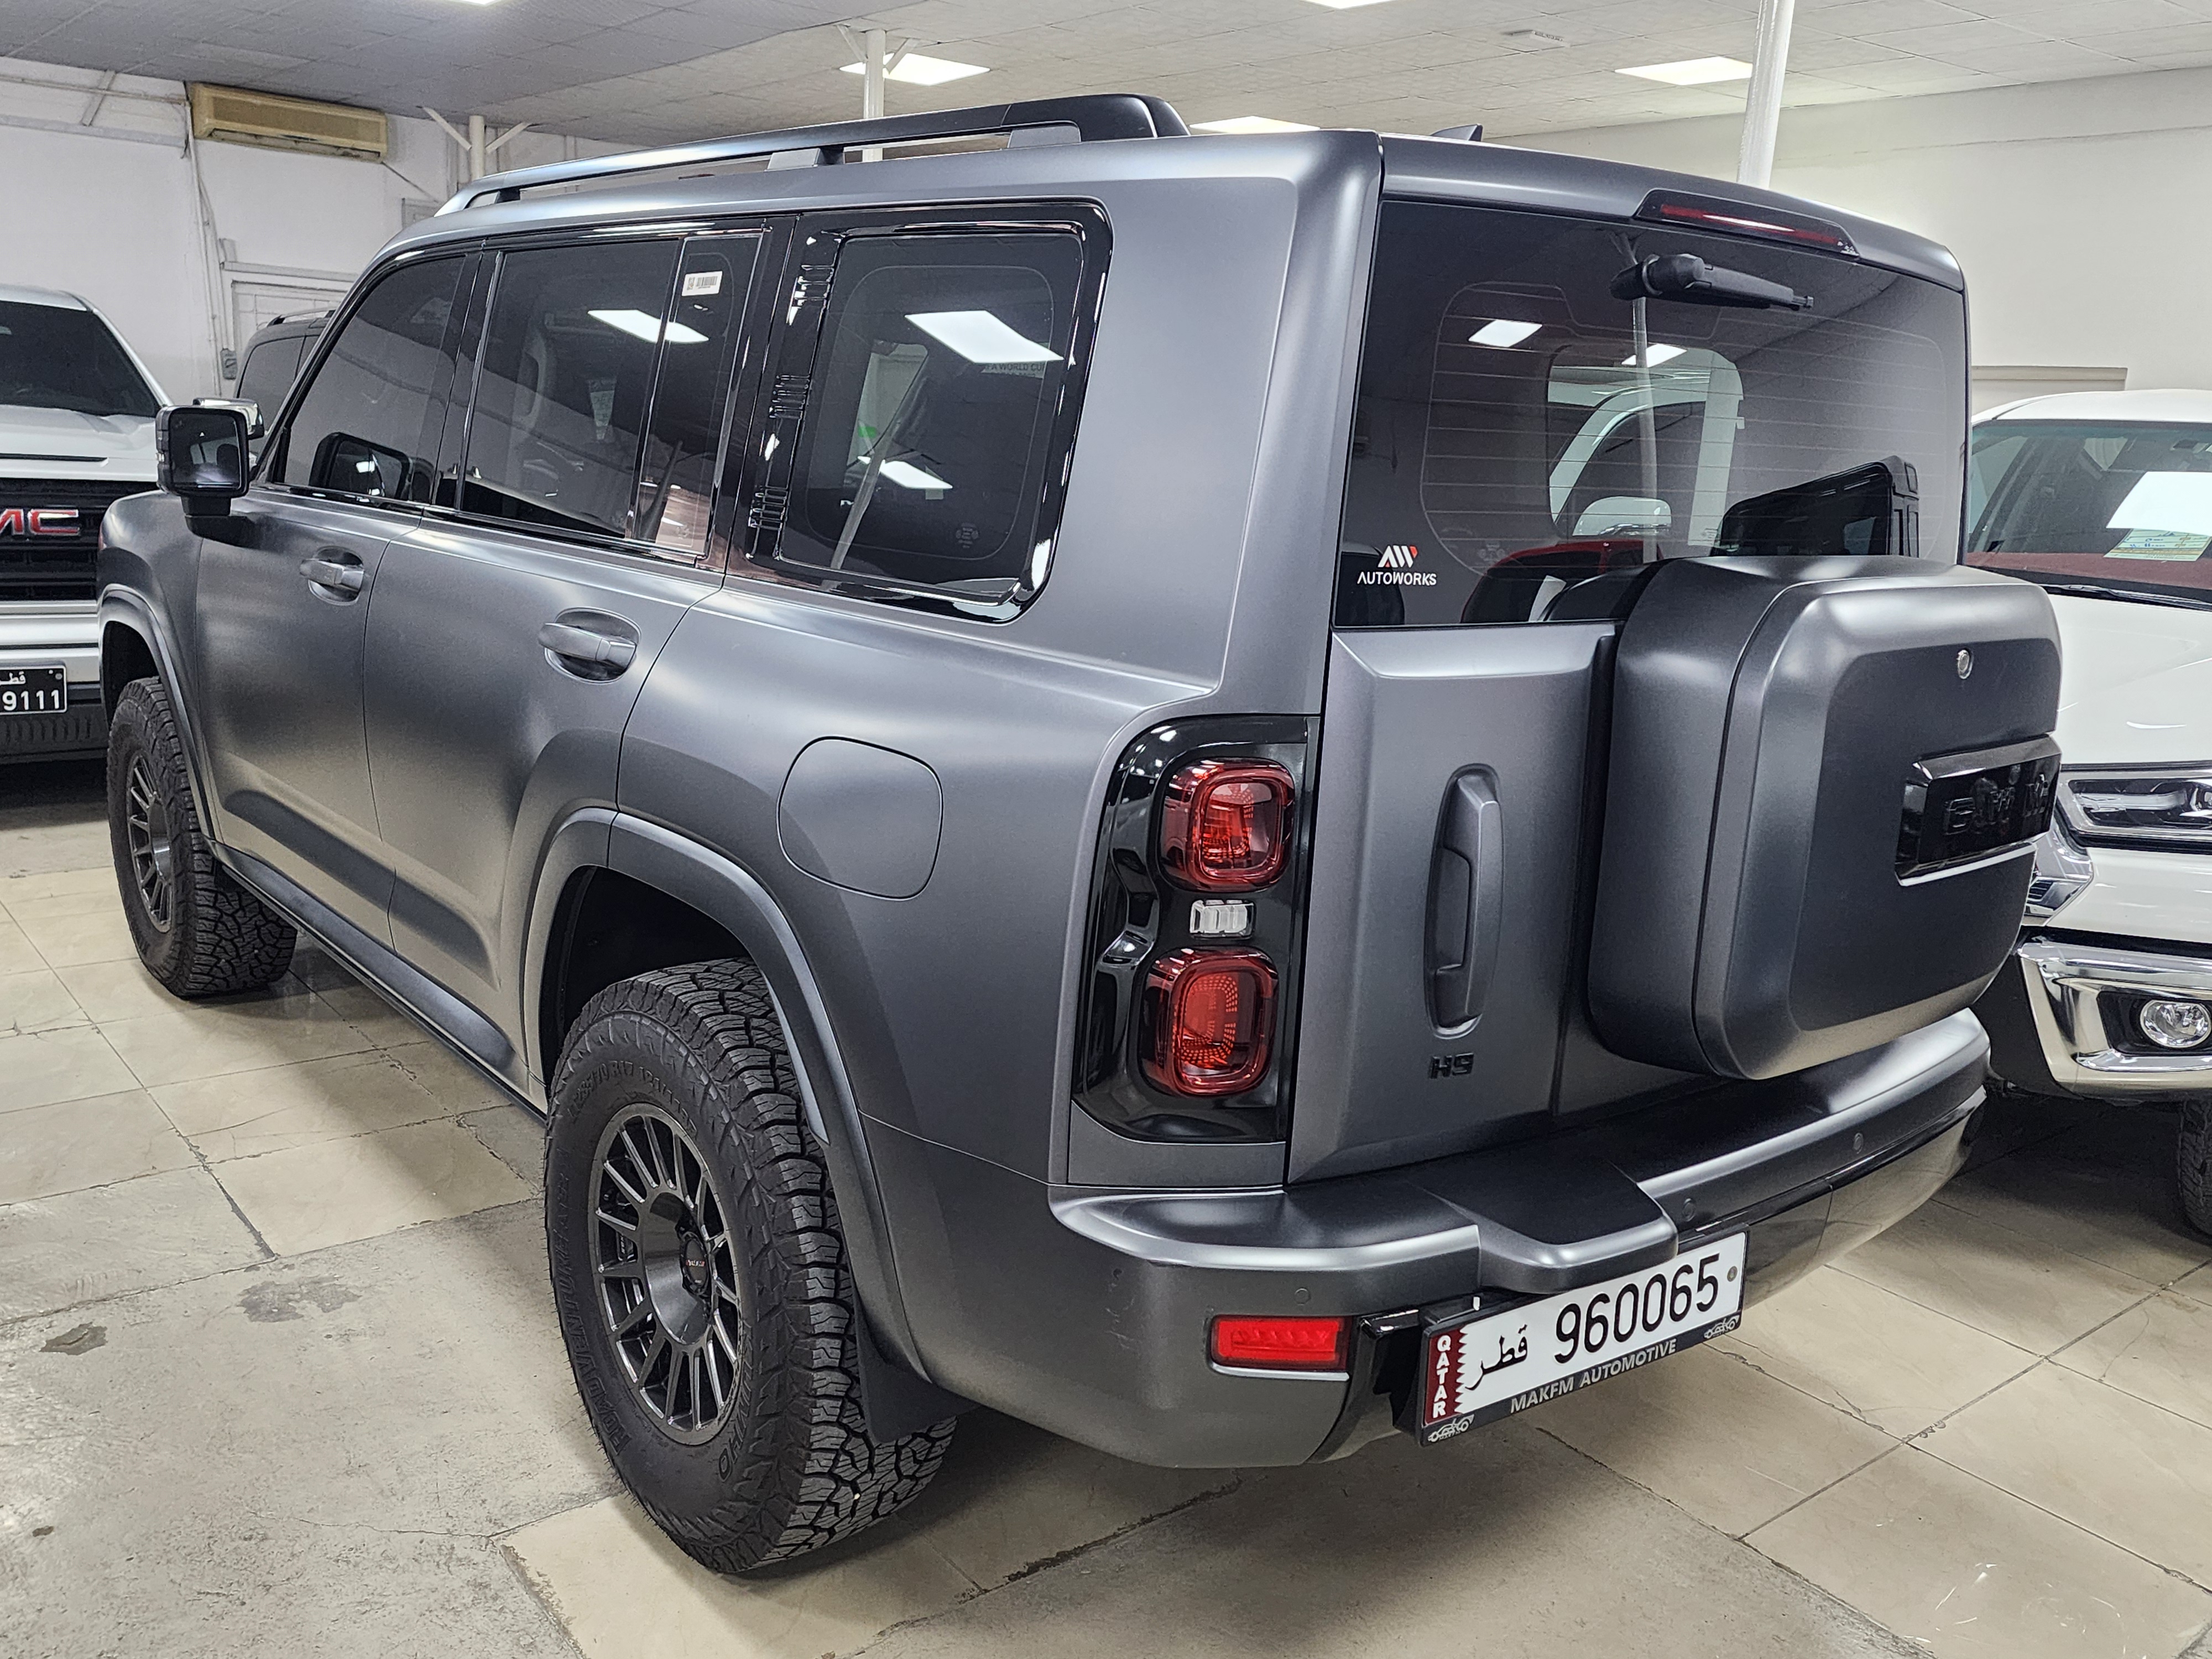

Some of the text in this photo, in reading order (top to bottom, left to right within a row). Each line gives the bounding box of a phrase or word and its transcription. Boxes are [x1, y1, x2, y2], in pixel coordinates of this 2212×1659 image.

[1357, 571, 1437, 586] AUTOWORKS
[2, 689, 60, 711] 9111
[1430, 1052, 1474, 1079] H9
[1554, 1253, 1720, 1364] 960065
[1432, 1334, 1452, 1418] QATAR
[1465, 1324, 1528, 1391] قطر
[1510, 1339, 1677, 1414] MAKFM AUTOMOTIVE
